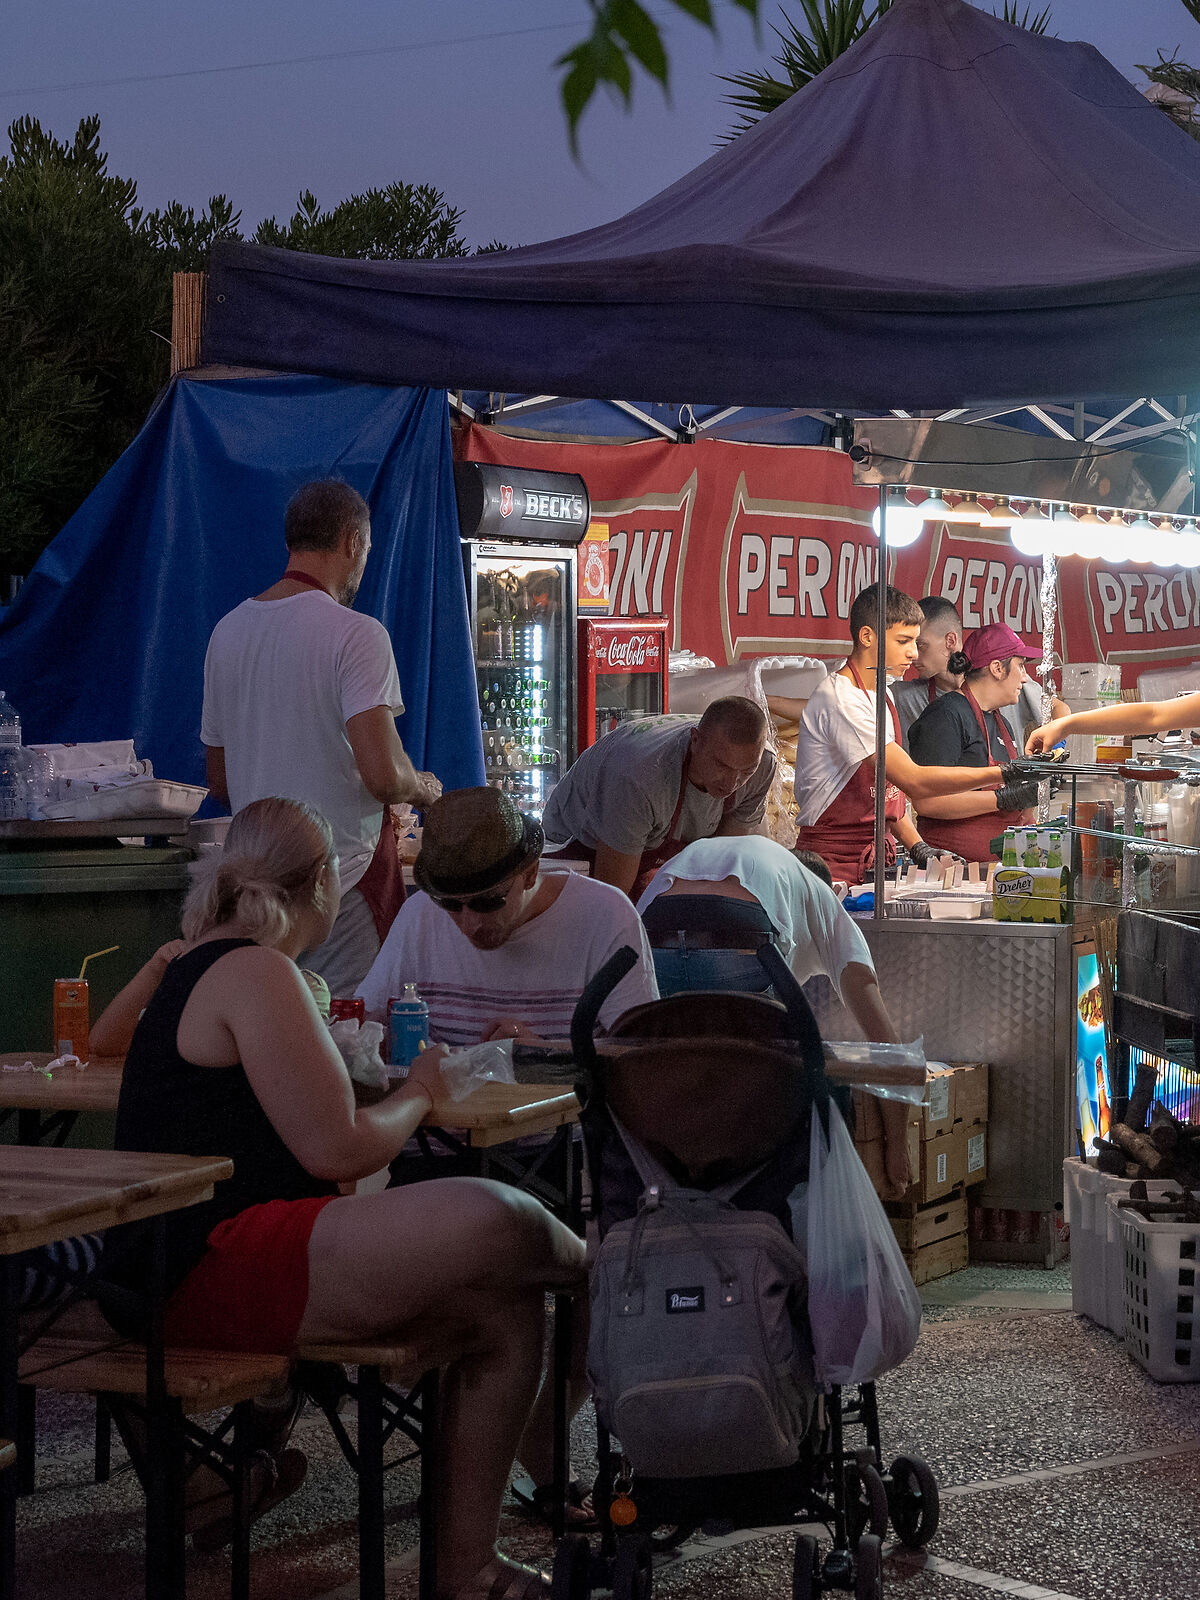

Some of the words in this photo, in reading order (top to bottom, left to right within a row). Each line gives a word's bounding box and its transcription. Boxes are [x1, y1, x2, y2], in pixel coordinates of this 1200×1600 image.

[525, 493, 583, 520] BECK'S
[941, 556, 1043, 633] PERON
[998, 879, 1032, 895] Dreher
